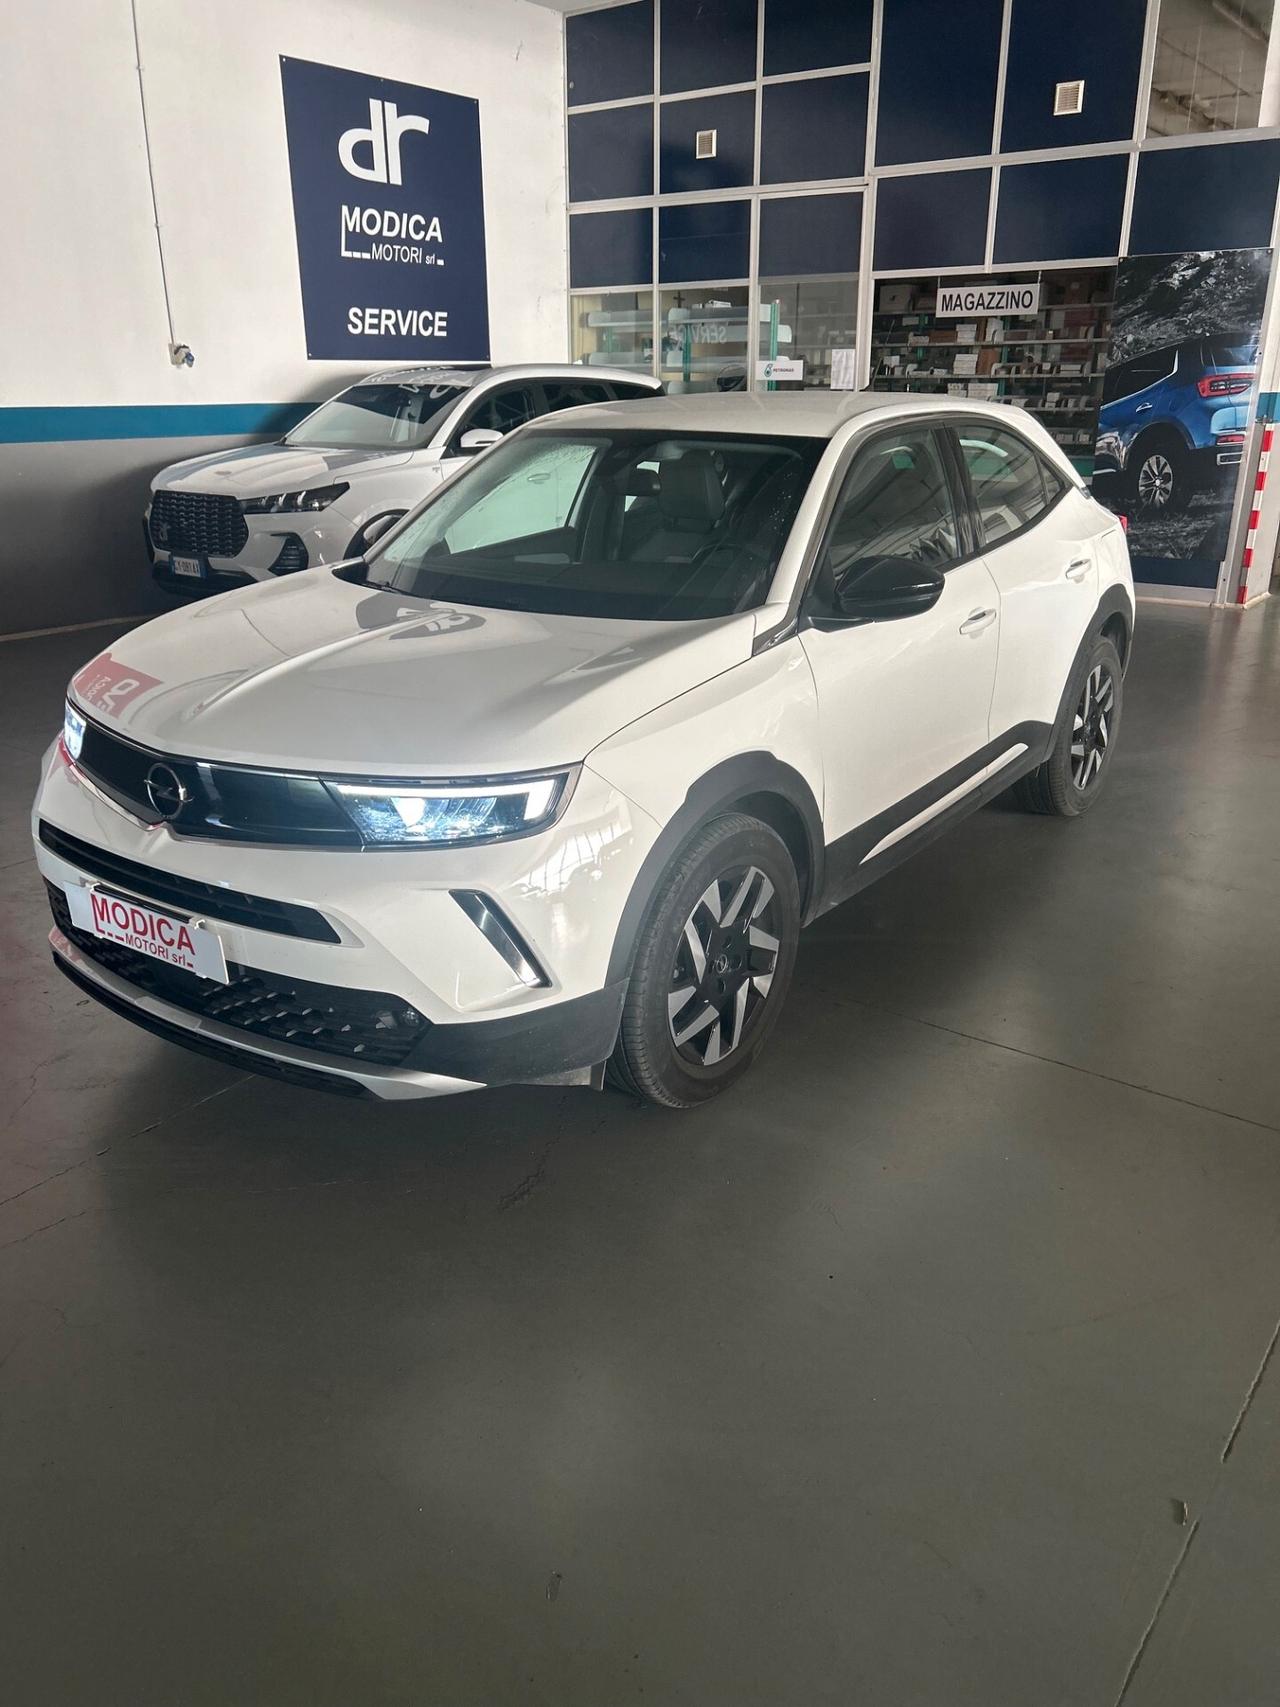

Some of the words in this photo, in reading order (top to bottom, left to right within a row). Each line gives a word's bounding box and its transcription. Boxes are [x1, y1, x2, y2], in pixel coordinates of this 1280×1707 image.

[338, 97, 430, 186] dr
[341, 204, 443, 242] MODICA
[371, 243, 423, 264] MOTORI
[425, 253, 436, 265] srl
[941, 290, 1033, 312] MAGAZZINO
[347, 306, 448, 337] SERVICE
[90, 893, 196, 956] MODICA
[125, 933, 169, 960] MOTORI
[171, 953, 186, 966] srl
